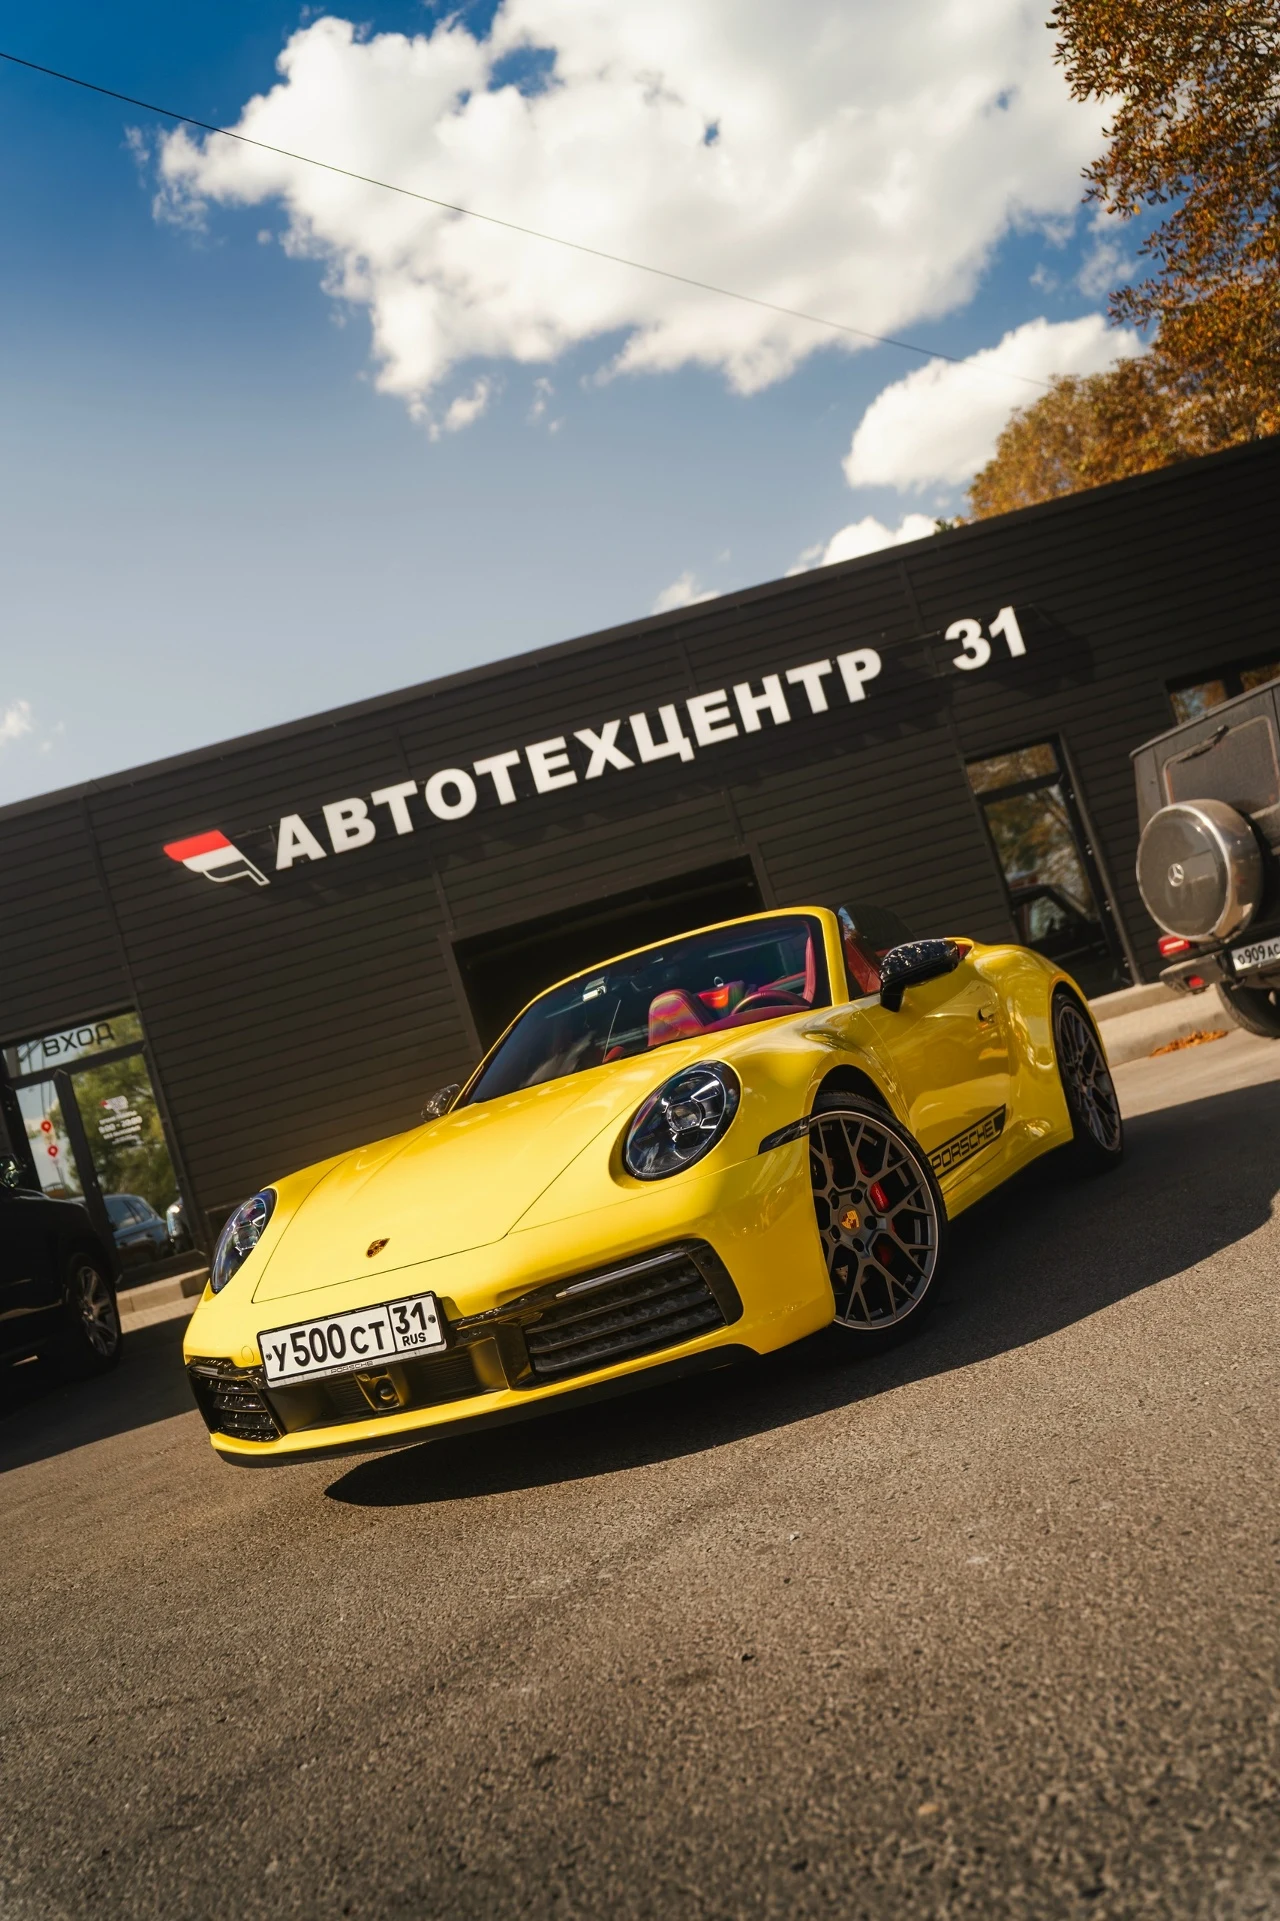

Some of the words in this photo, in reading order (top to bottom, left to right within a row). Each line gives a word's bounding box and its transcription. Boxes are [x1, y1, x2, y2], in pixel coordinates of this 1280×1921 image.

[274, 647, 883, 871] АВТОТЕХЦЕНТР
[943, 605, 1027, 671] 31
[42, 1021, 115, 1057] ВХОД
[930, 1119, 994, 1170] PORSCHE
[392, 1301, 428, 1335] 31
[402, 1332, 427, 1347] RUS
